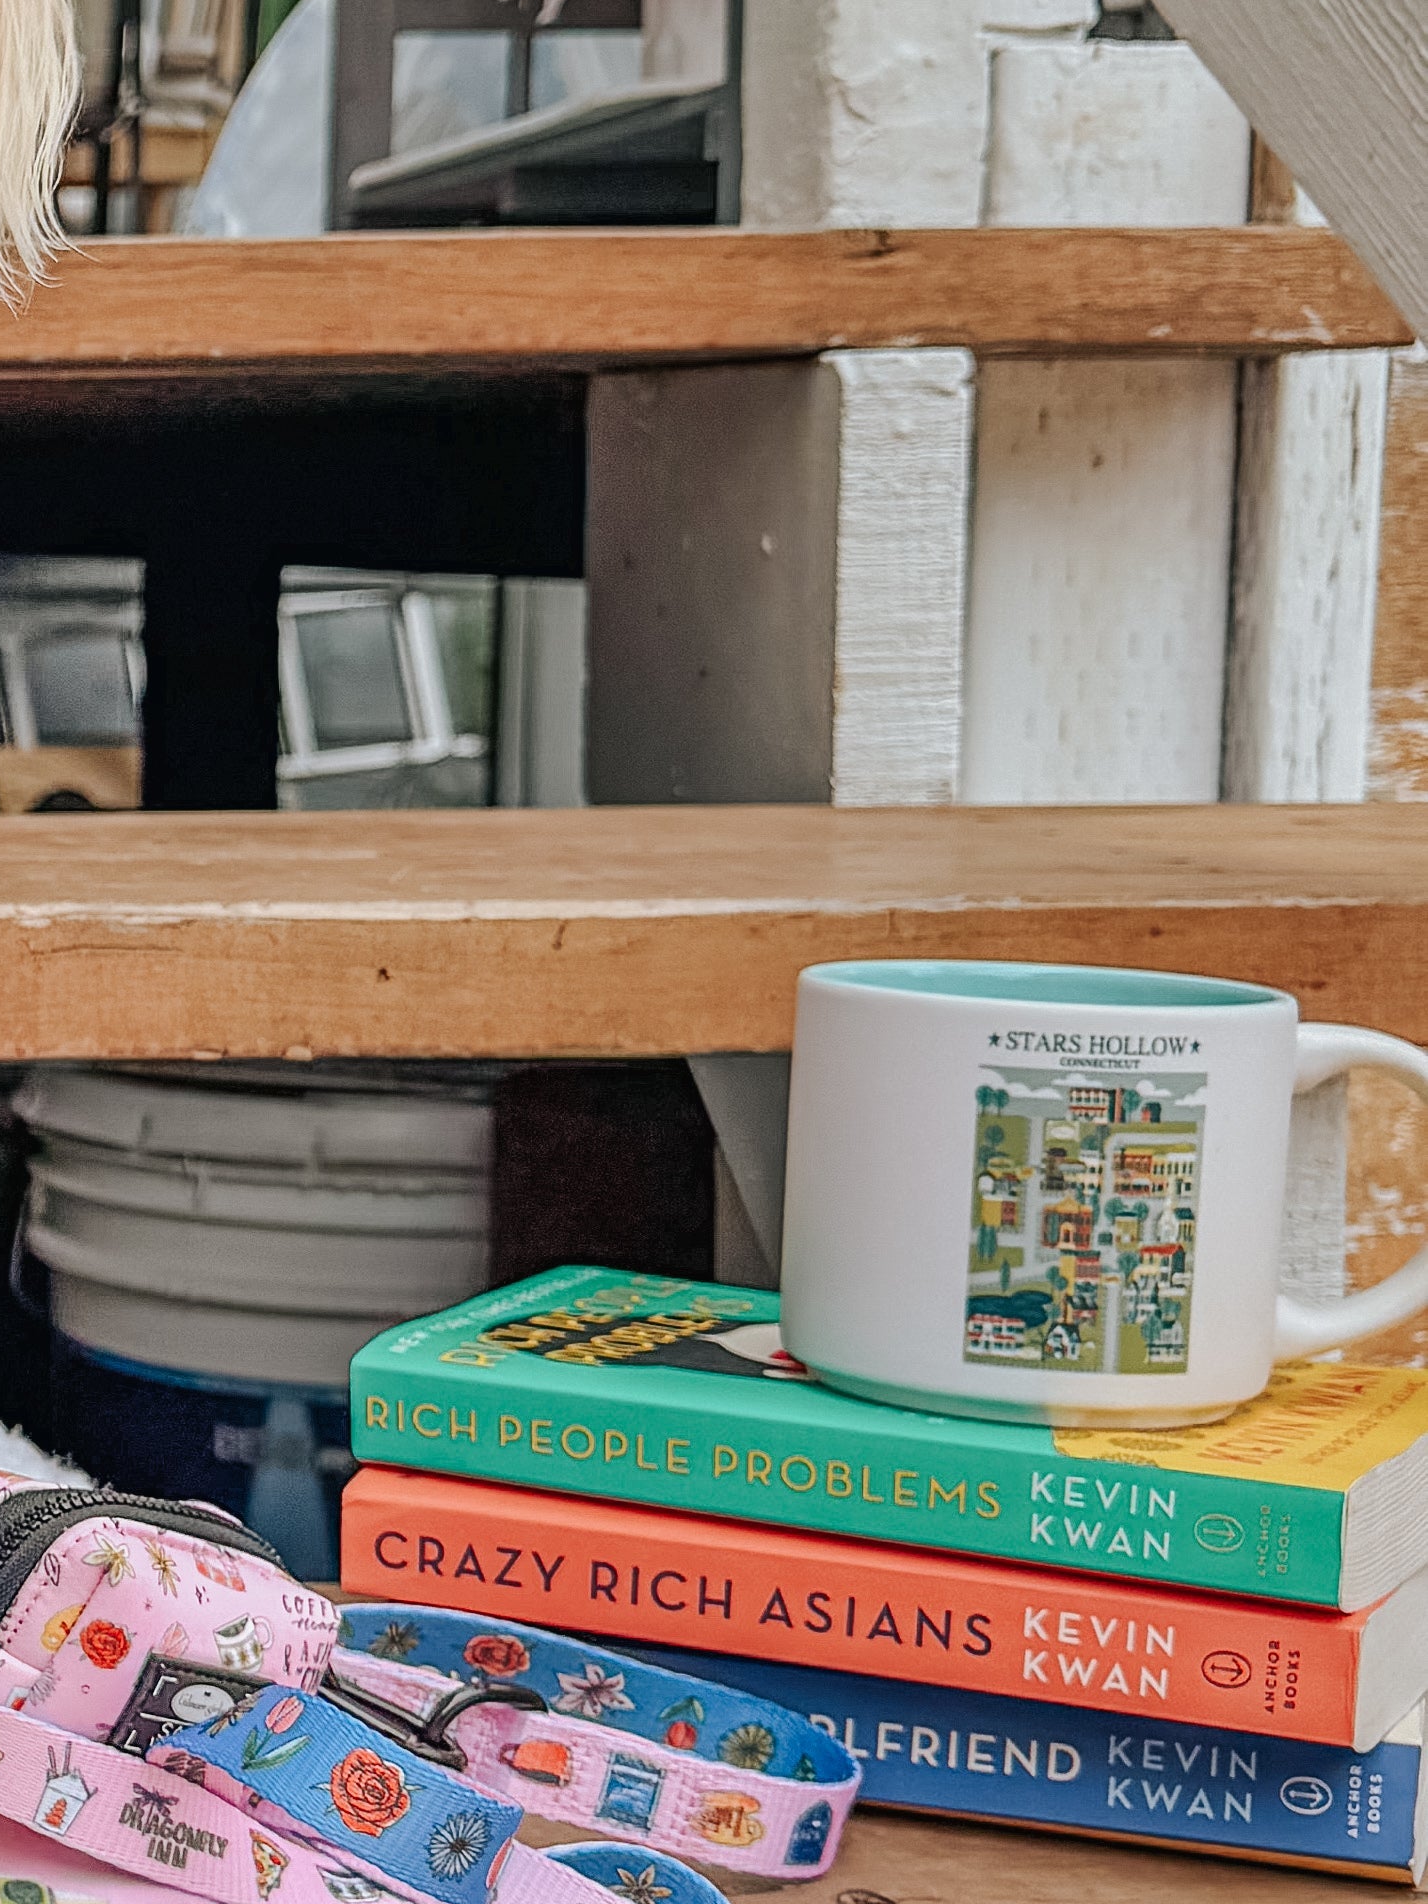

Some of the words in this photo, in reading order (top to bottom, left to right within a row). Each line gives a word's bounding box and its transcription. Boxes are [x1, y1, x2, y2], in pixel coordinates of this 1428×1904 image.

[1004, 1030, 1082, 1055] STARS
[1088, 1035, 1189, 1057] HOLLOW
[1058, 1055, 1142, 1070] CONNECTICUT
[364, 1394, 478, 1445] RICH
[497, 1412, 693, 1476] PEOPLE
[712, 1442, 1004, 1521] PROBLEMS
[1029, 1470, 1177, 1521] KEVIN
[1028, 1511, 1173, 1563] KWAN
[373, 1529, 566, 1594] CRAZY
[589, 1560, 734, 1622] RICH
[757, 1585, 994, 1659] ASIANS
[1021, 1605, 1176, 1659] KEVIN
[1021, 1648, 1170, 1701] KWAN
[1264, 1639, 1282, 1715] ANCHOR
[1283, 1648, 1302, 1710] BOOKS
[811, 1712, 1083, 1783] LFRIEND
[1107, 1734, 1259, 1782] KEVIN
[1106, 1775, 1253, 1824] KWAN
[1345, 1764, 1364, 1840] ANCHOR
[1366, 1773, 1384, 1835] BOOKS
[118, 1800, 229, 1860] DRAGONFLY
[146, 1832, 190, 1870] INN
